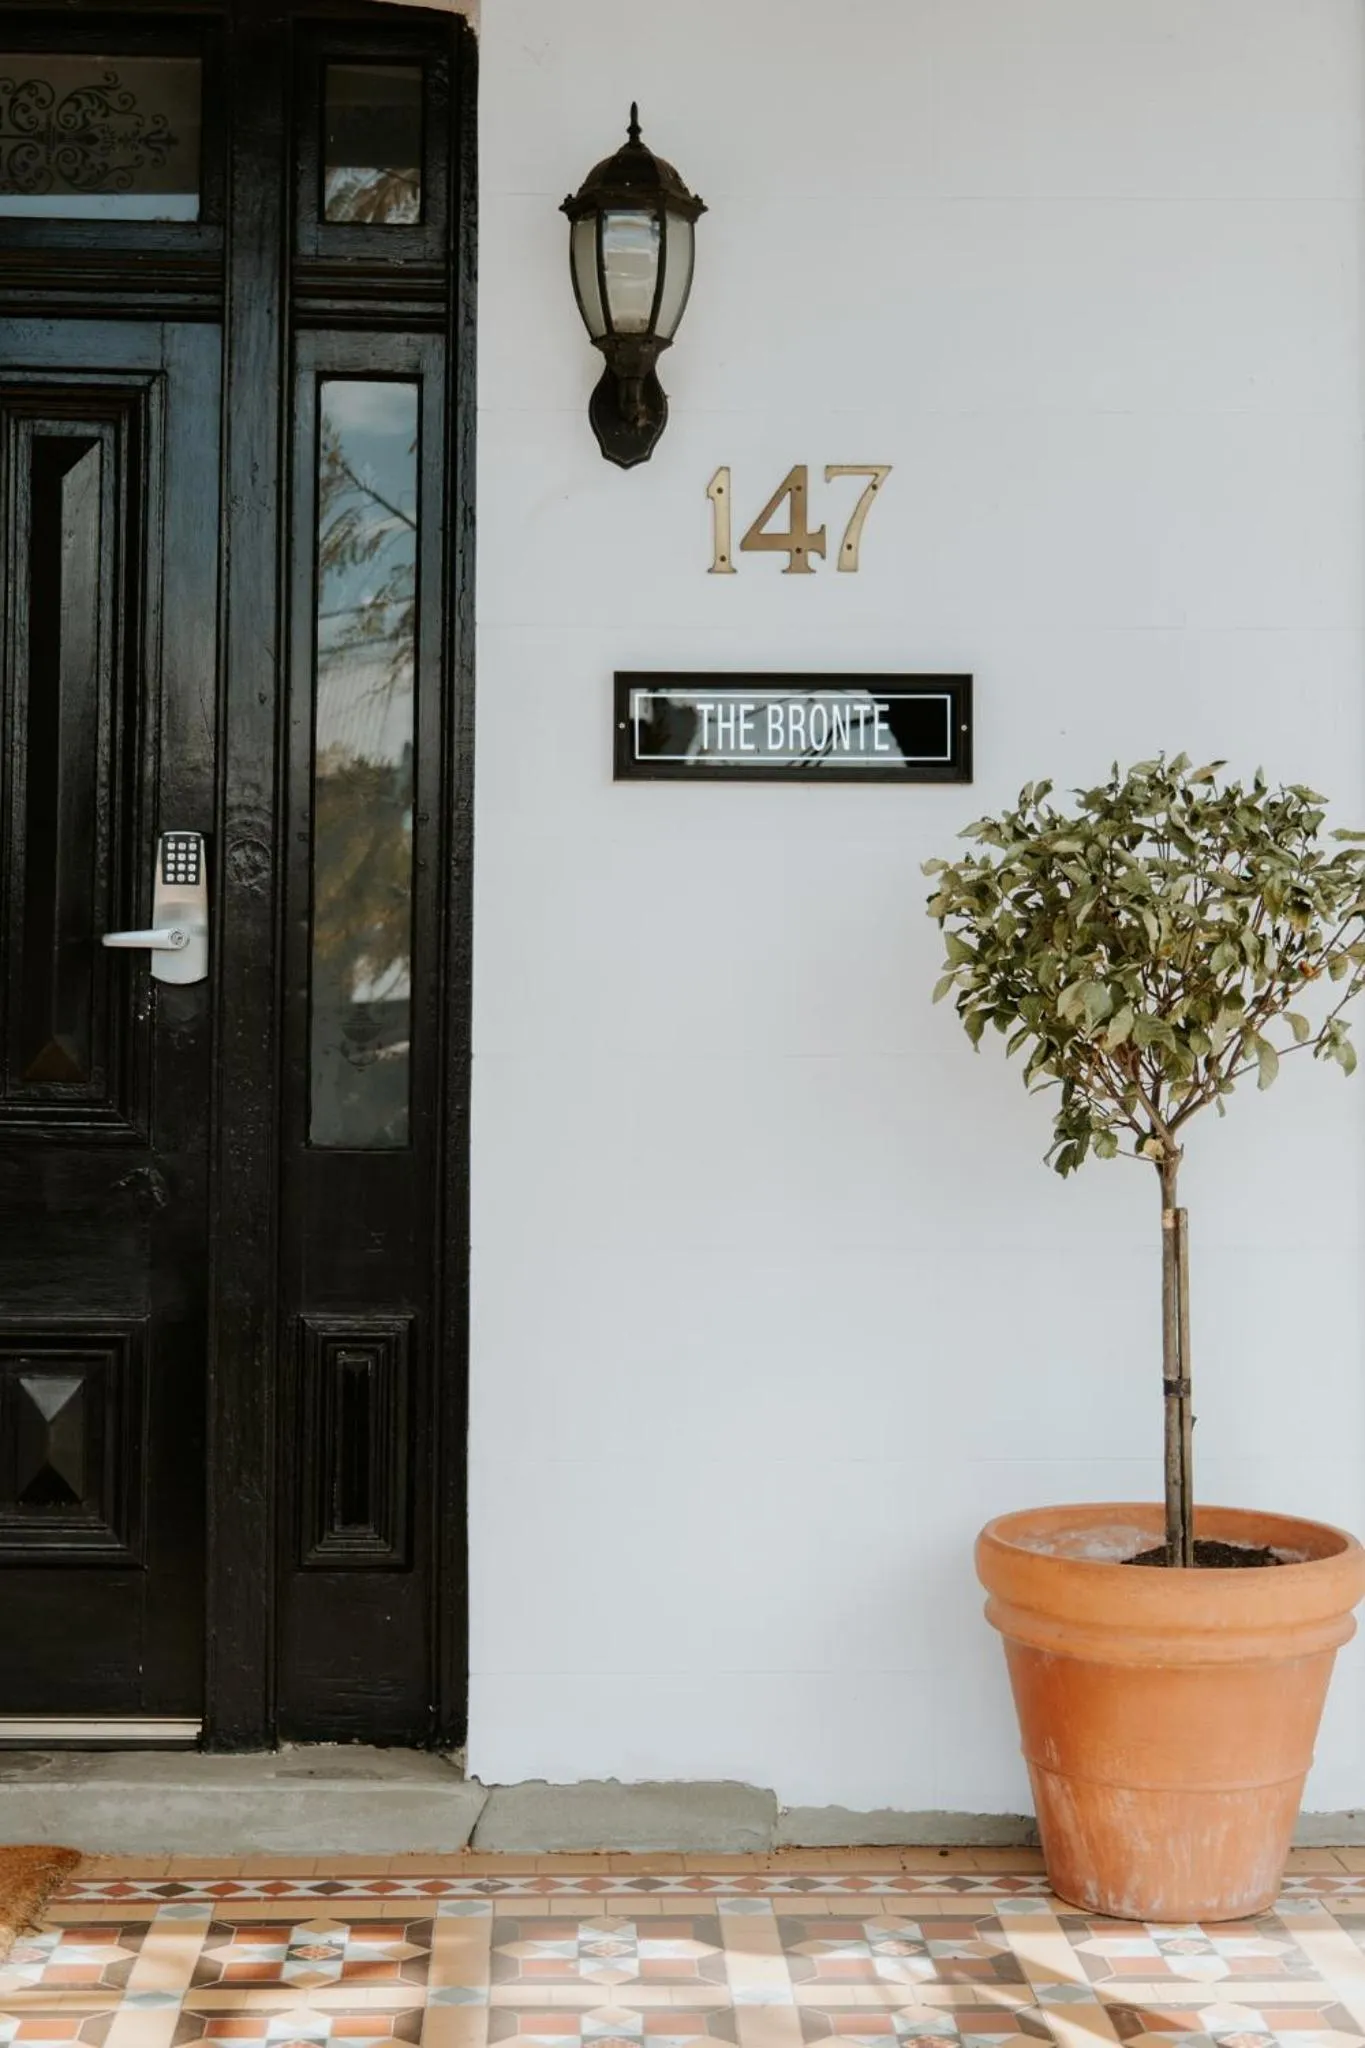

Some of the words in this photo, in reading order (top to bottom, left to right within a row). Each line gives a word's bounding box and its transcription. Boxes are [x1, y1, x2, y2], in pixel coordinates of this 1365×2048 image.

[706, 464, 893, 574] 147
[696, 703, 755, 751] THE
[767, 703, 890, 751] BRONTE
